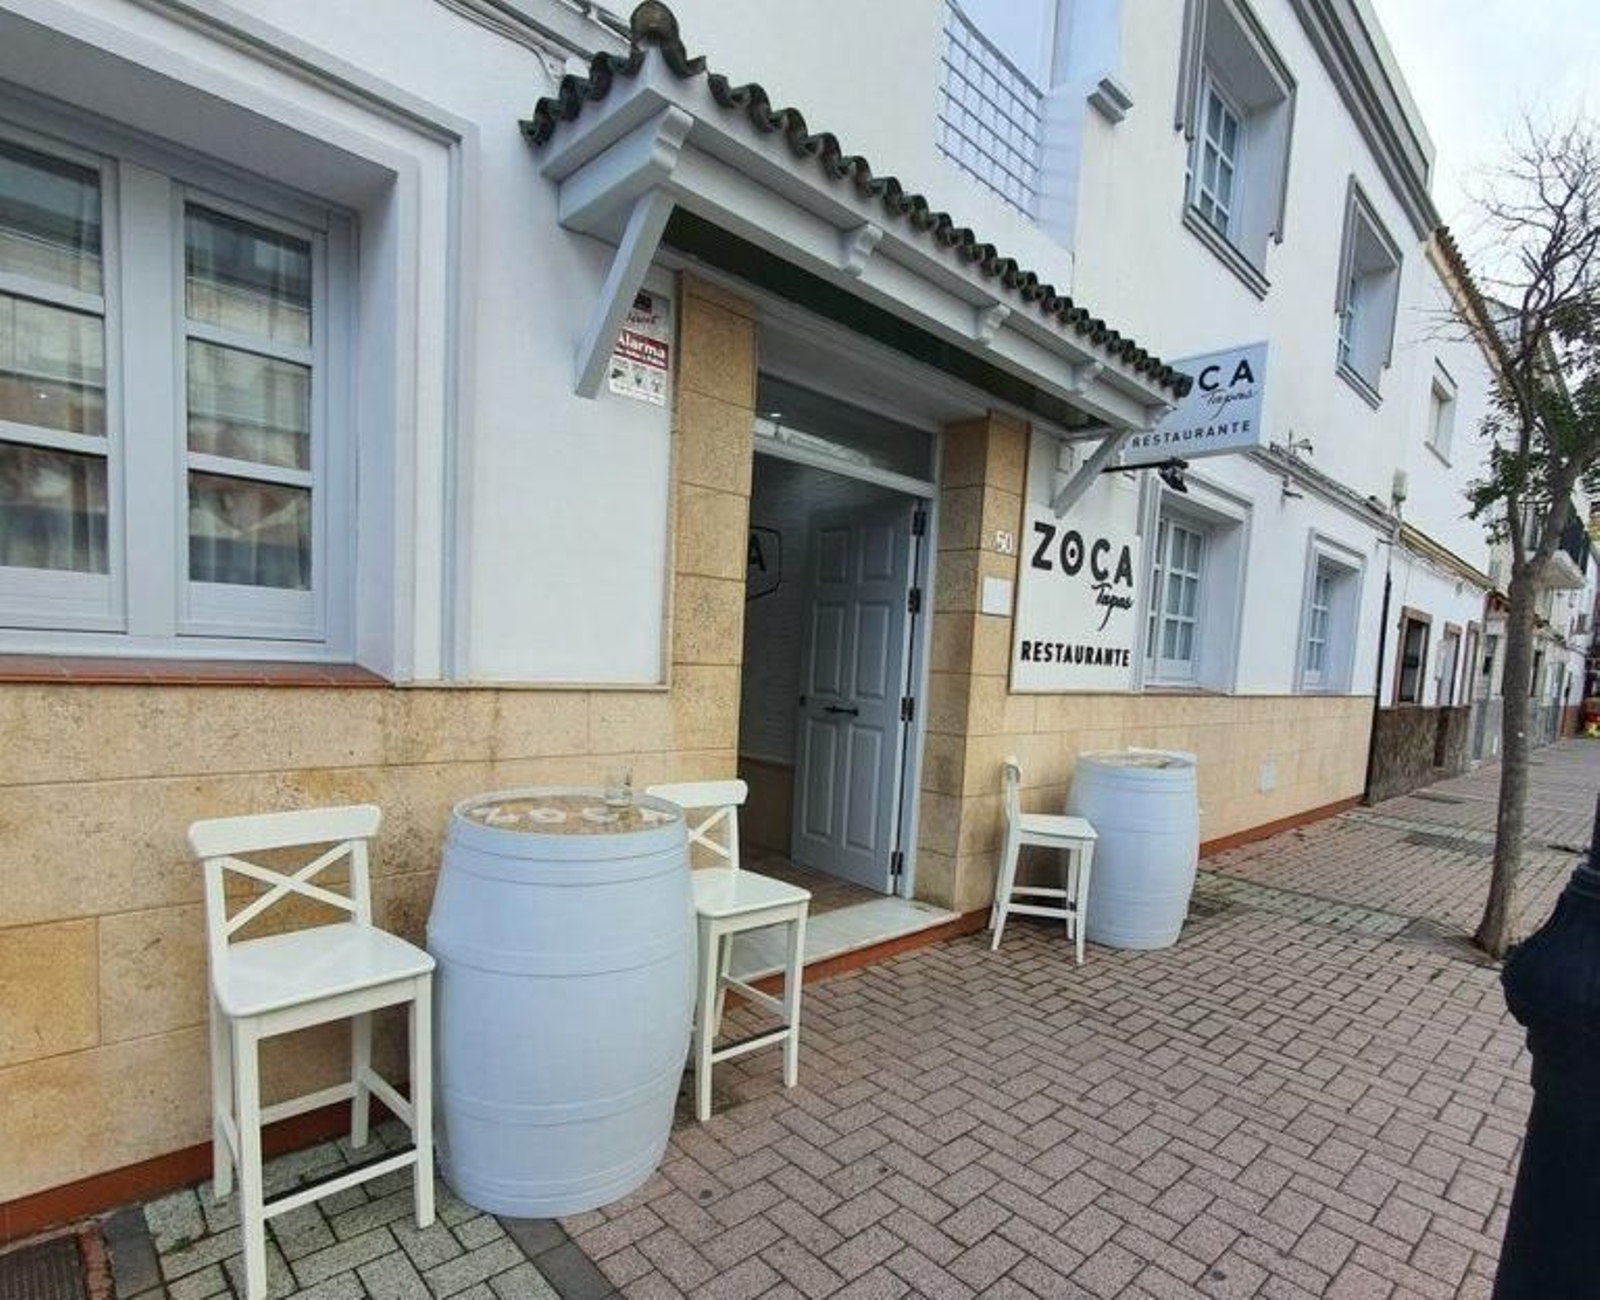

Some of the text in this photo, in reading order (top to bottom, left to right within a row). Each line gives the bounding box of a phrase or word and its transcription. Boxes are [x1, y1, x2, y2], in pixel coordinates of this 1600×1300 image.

[617, 330, 666, 358] Alarma
[1185, 359, 1254, 395] CA
[1132, 420, 1250, 448] RESTAURANTE
[1031, 520, 1133, 588] ZOCA
[1091, 583, 1134, 631] Tapas
[1020, 640, 1131, 667] RESTAURANTE
